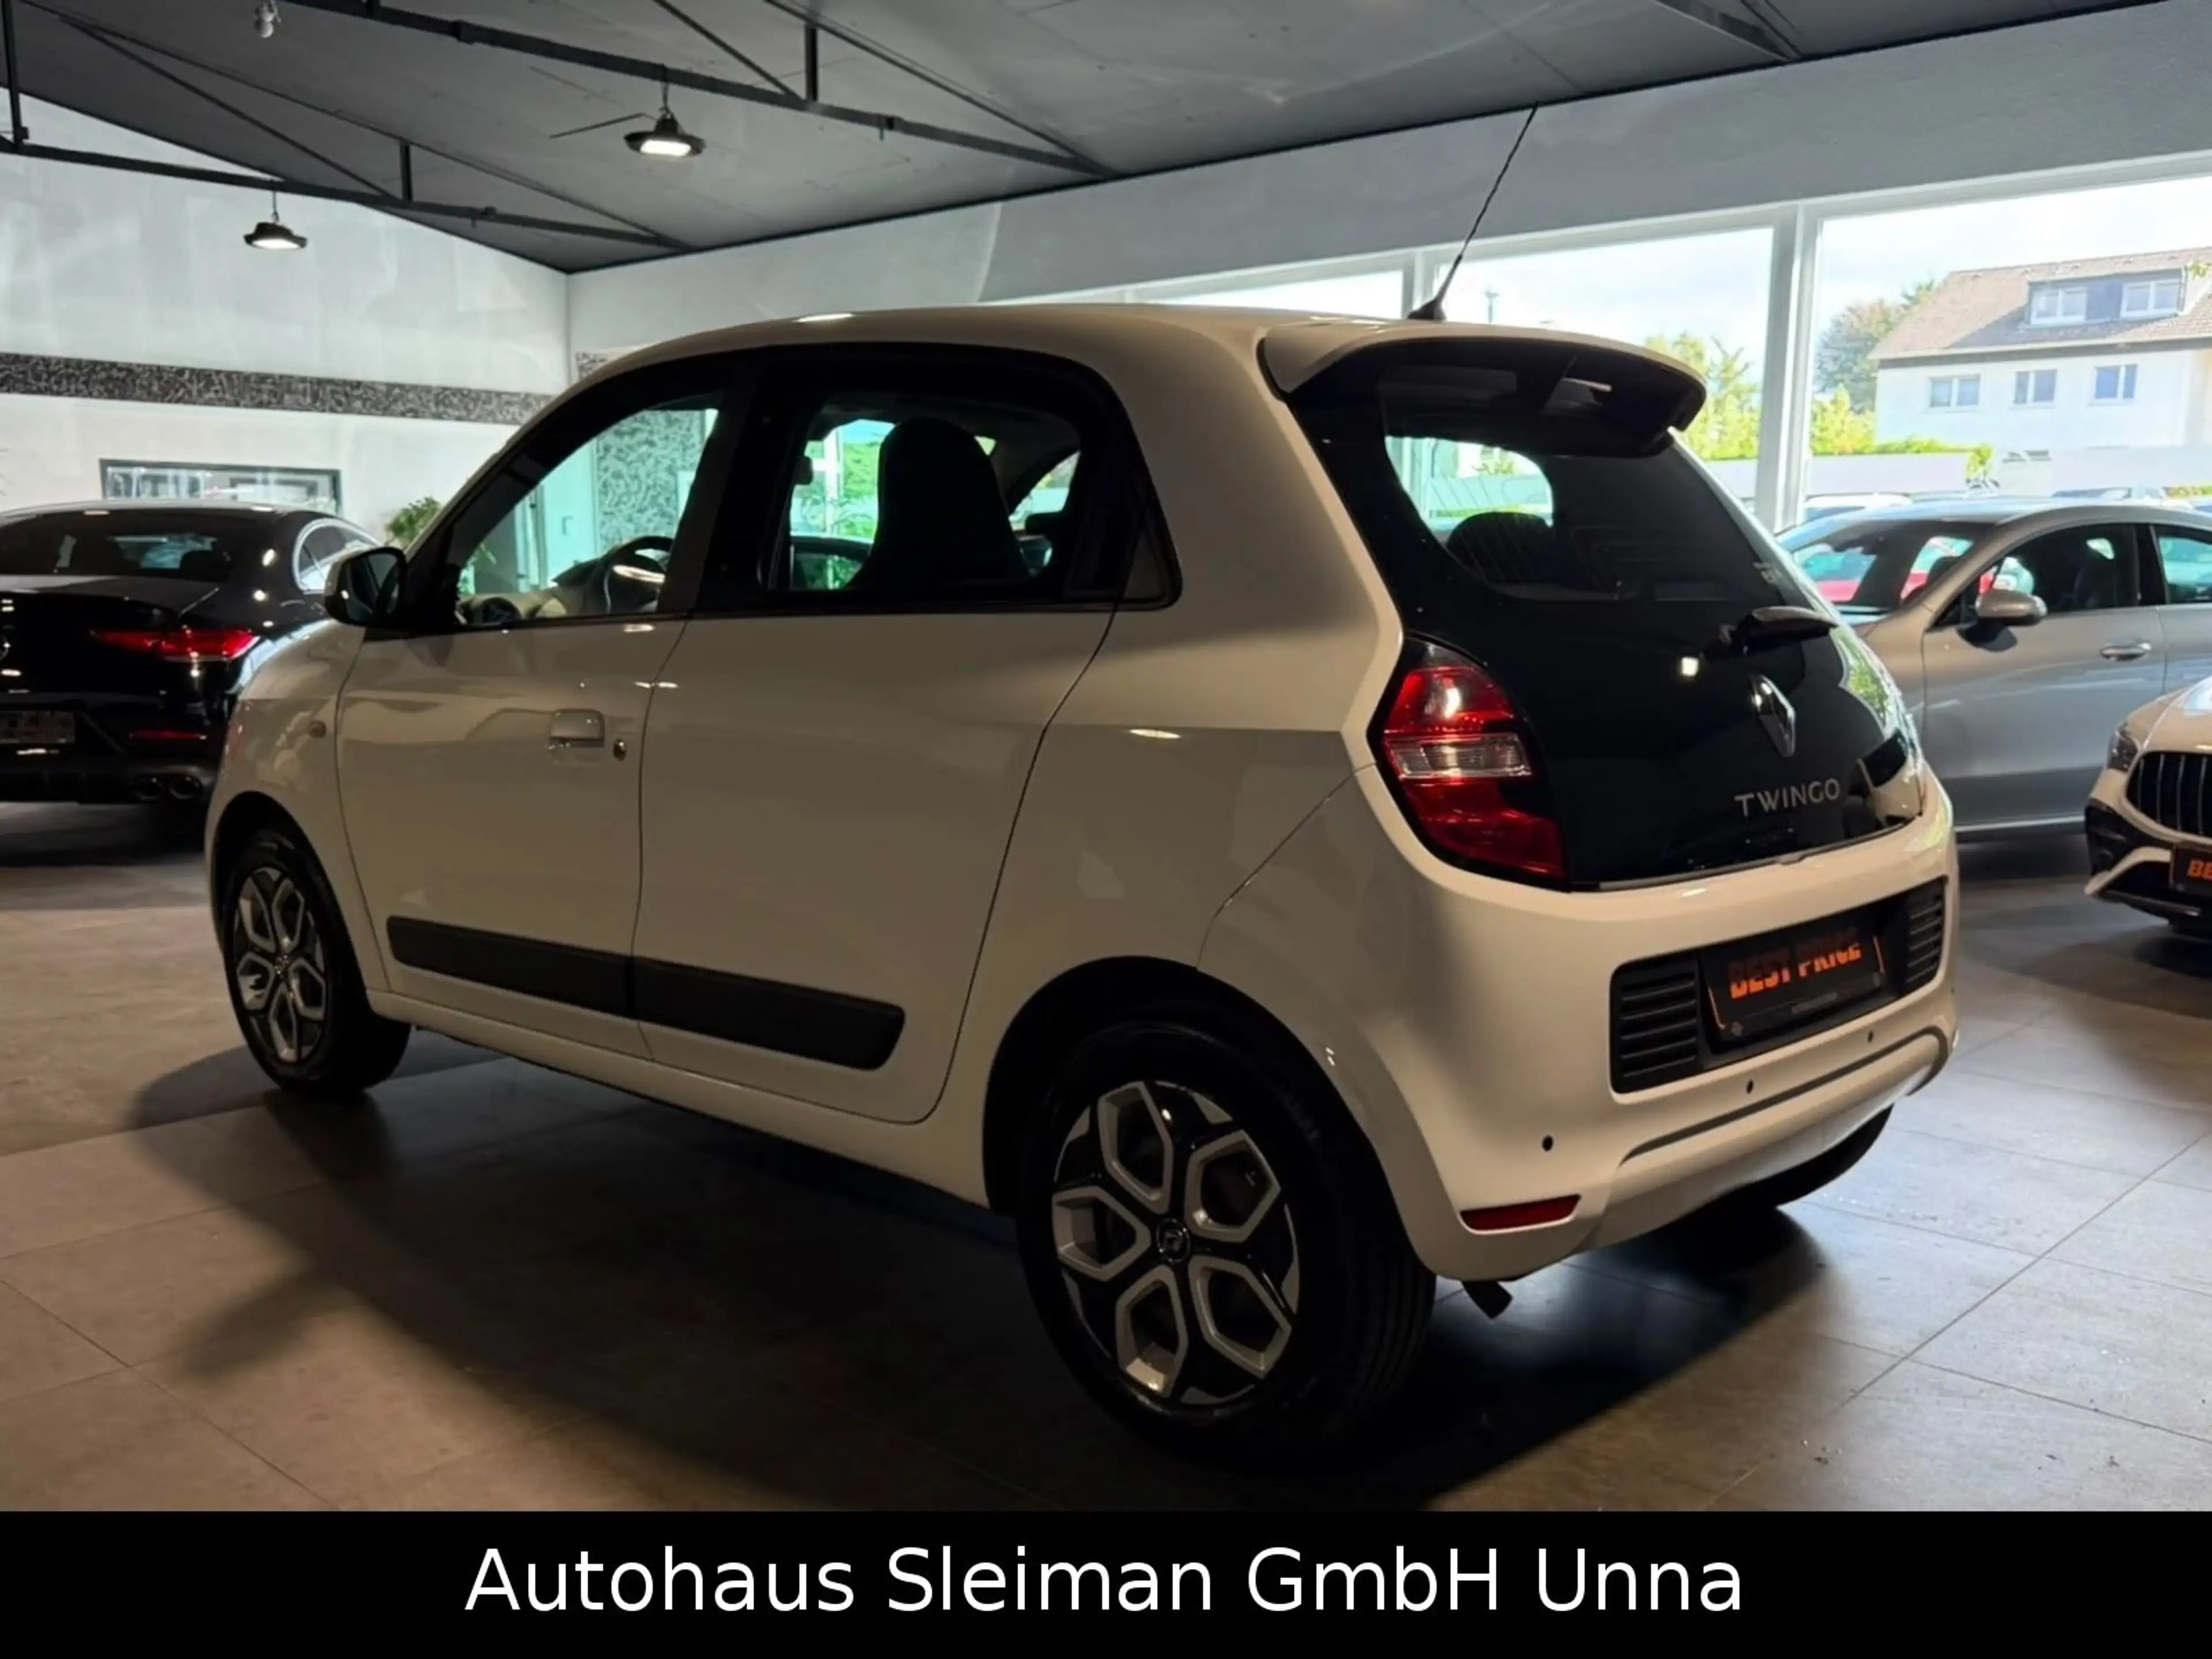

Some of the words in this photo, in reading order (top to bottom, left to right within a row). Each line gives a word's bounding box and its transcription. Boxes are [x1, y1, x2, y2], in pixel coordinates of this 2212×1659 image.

[1733, 778, 1840, 817] TWINGO
[1729, 948, 1791, 999] BEST
[1794, 928, 1862, 978] PRICE
